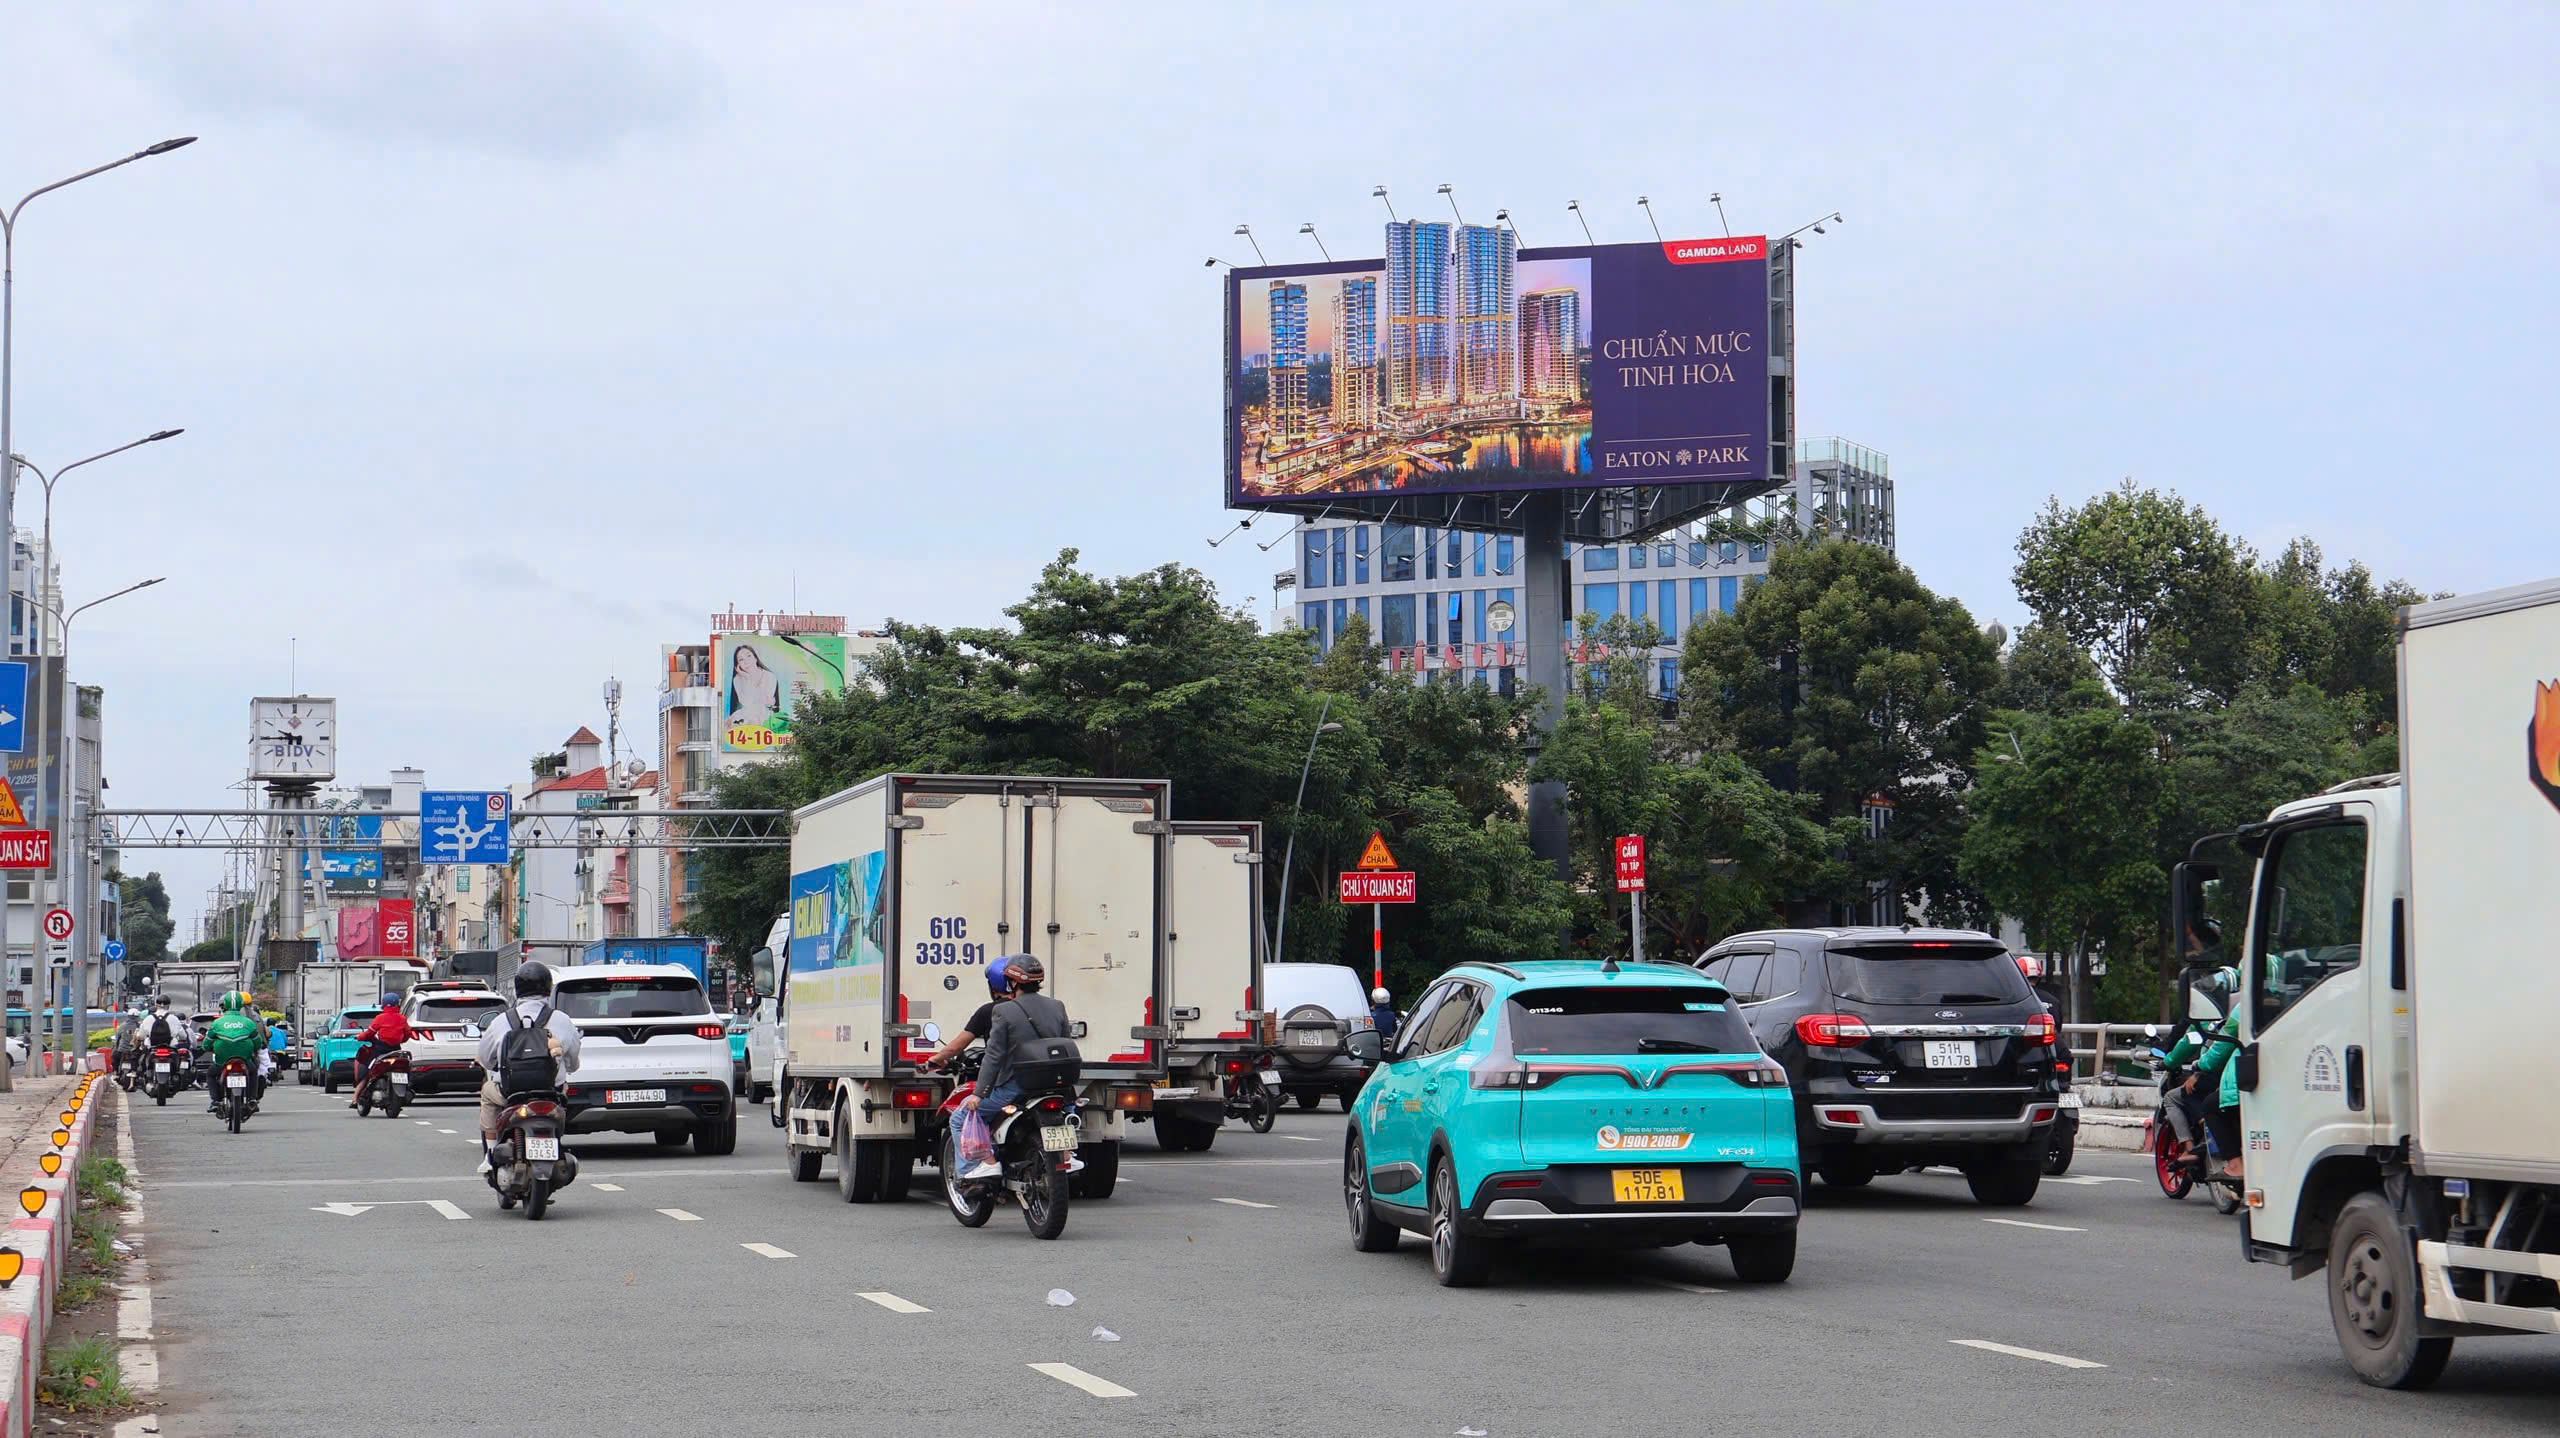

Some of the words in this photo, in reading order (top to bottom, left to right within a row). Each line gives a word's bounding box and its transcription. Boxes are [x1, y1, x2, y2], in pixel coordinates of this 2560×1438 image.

[1677, 246, 1726, 259] GAMUDA
[1728, 243, 1757, 255] LAND
[1603, 329, 1687, 359] CHUẨN
[1695, 330, 1752, 357] MỰC
[1618, 365, 1675, 388] TINH
[1682, 362, 1736, 384] HOA
[1605, 450, 1671, 468] EATON
[1696, 446, 1750, 464] PARK
[728, 730, 773, 745] 14-16
[275, 745, 314, 757] BIDV
[25, 835, 48, 861] SÁT
[1622, 841, 1638, 858] CẤM
[1342, 875, 1361, 896] CHÚ
[1362, 874, 1369, 896] Ý
[1369, 879, 1395, 897] QUAN
[1396, 874, 1413, 896] SÁT
[386, 925, 409, 940] 5G
[930, 916, 967, 939] 61C
[916, 942, 985, 965] 339.91
[223, 1021, 244, 1029] Grab
[1939, 1044, 1961, 1054] 51H
[1622, 1135, 1649, 1148] 1900
[1650, 1134, 1680, 1148] 2088
[1632, 1170, 1663, 1185] 50E
[1624, 1185, 1676, 1200] 117.81
